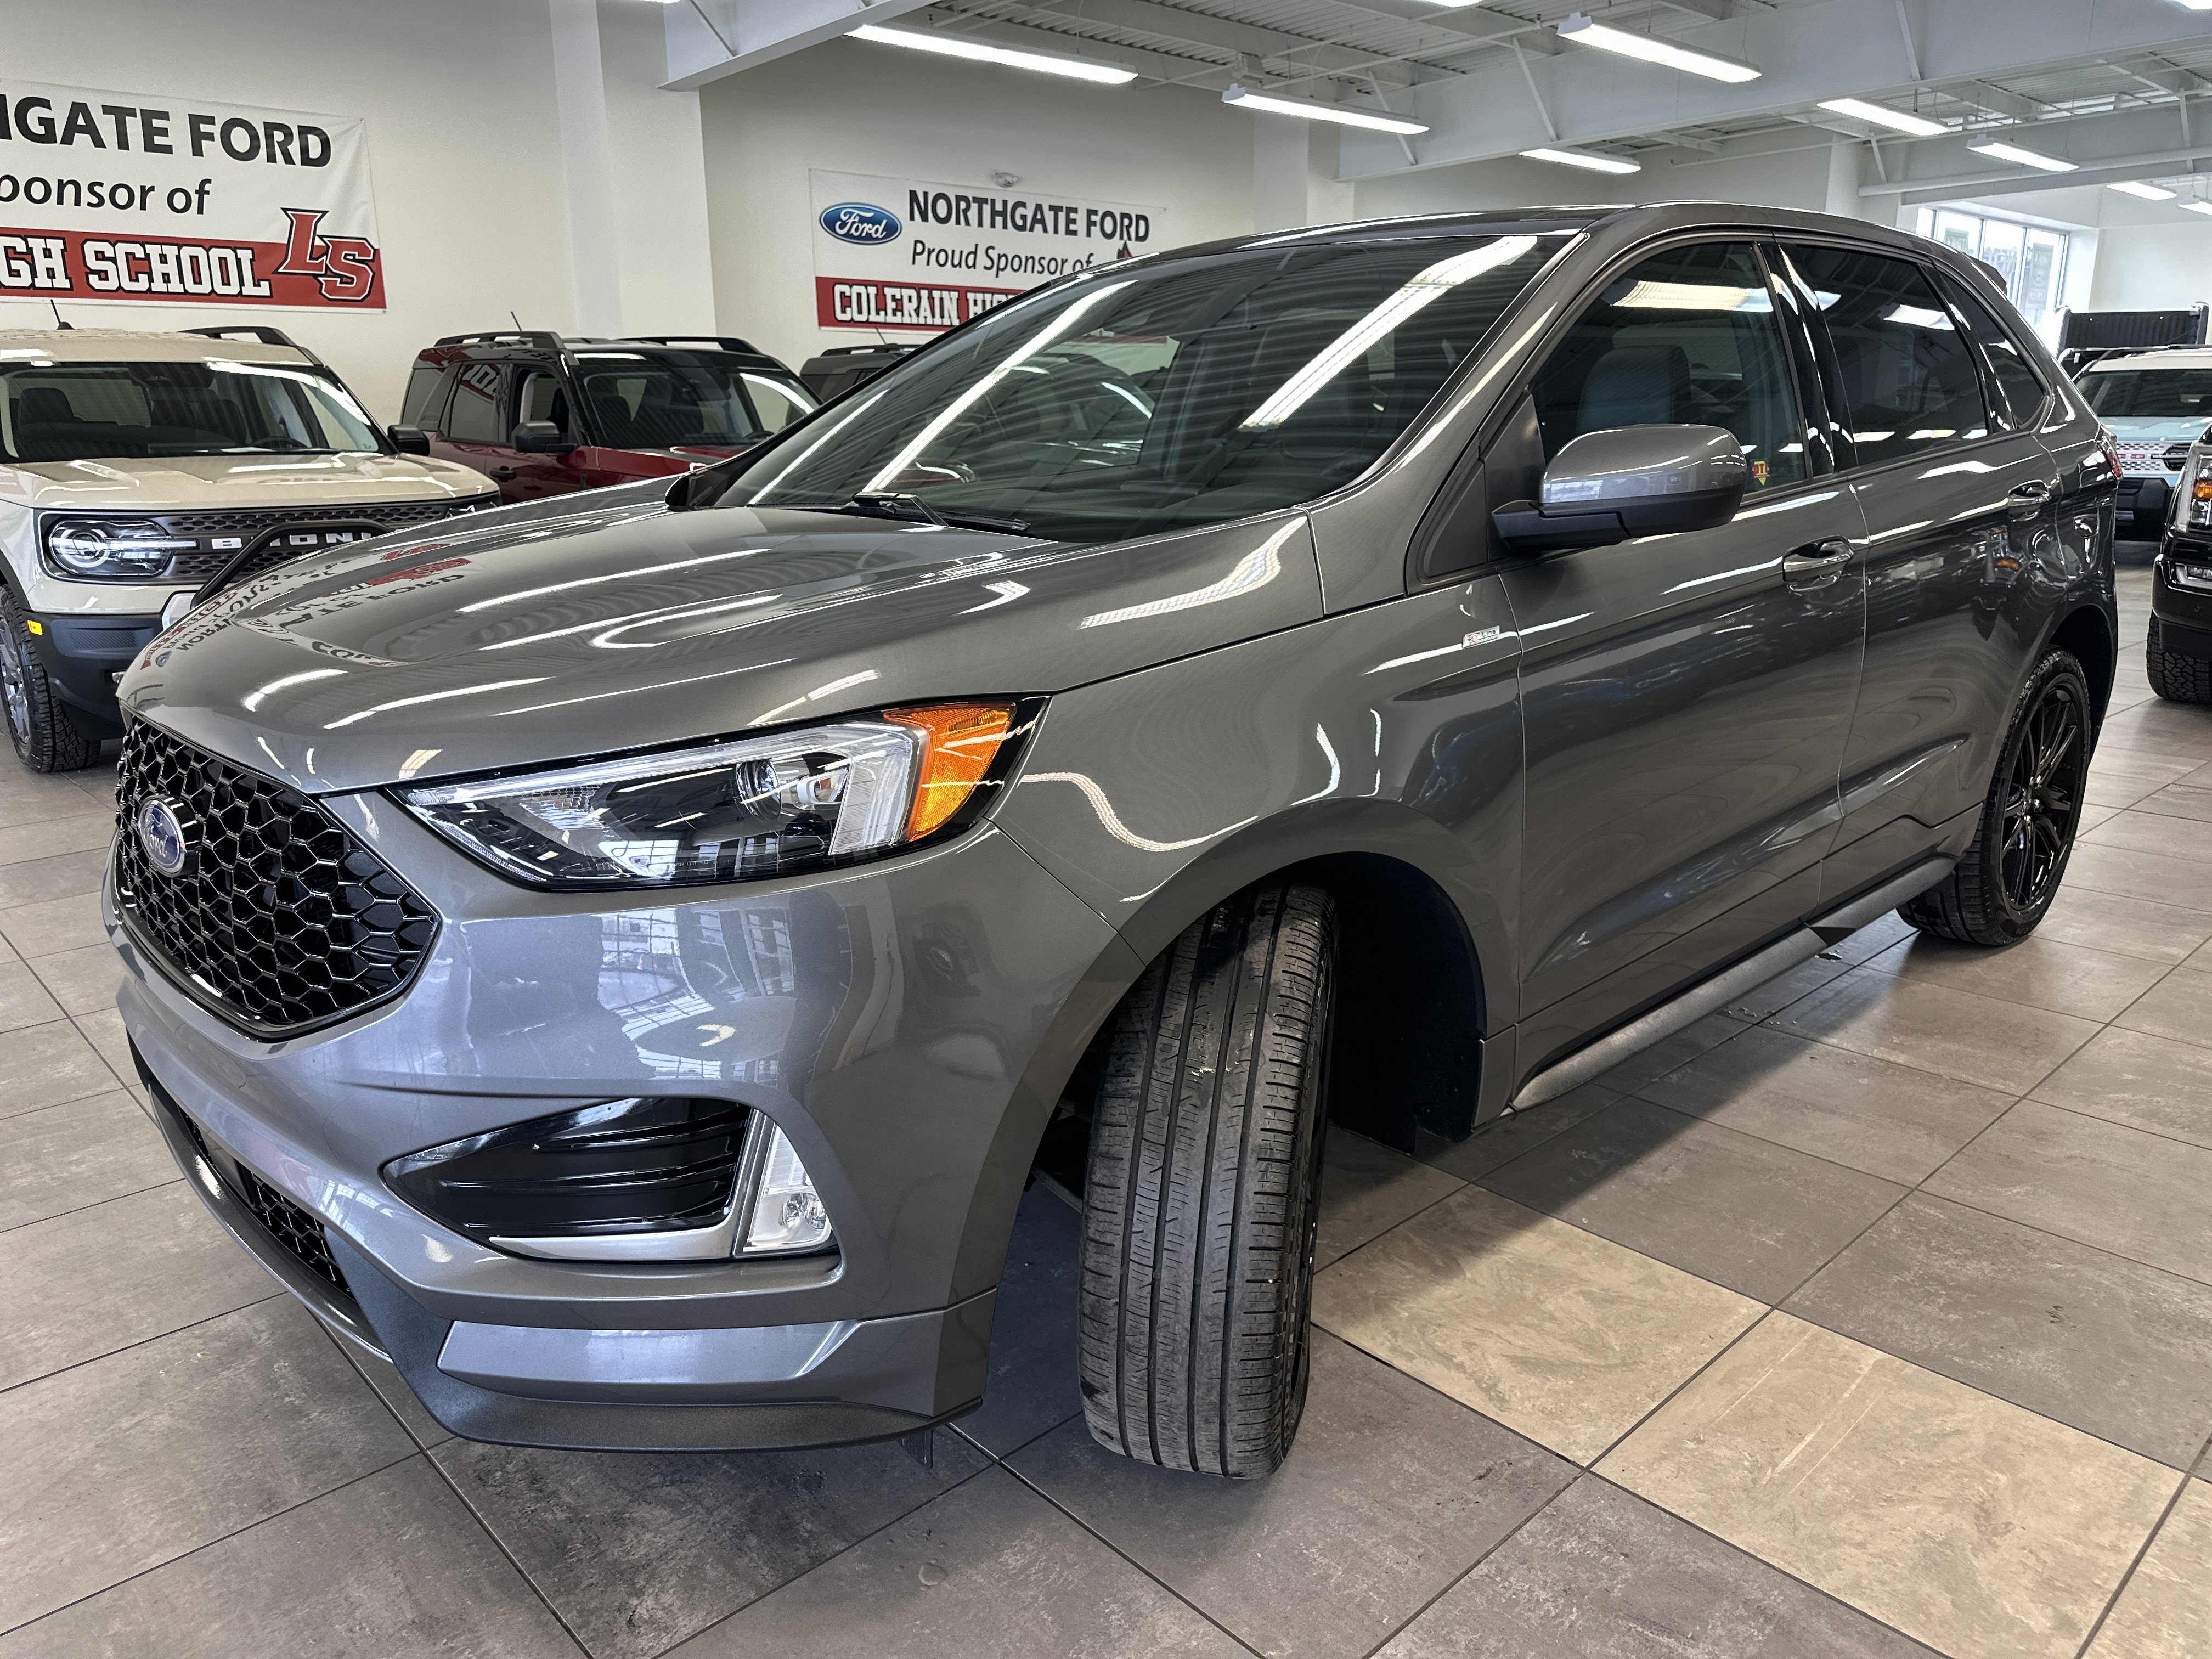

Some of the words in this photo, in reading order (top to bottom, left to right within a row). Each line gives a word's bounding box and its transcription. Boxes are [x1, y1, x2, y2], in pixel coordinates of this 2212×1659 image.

[0, 93, 173, 155] GATE
[188, 114, 332, 167] FORD
[166, 178, 212, 215] of
[909, 189, 1078, 237] NORTHGATE
[1086, 209, 1150, 242] FORD
[834, 208, 887, 239] Ford
[81, 239, 273, 299] SCHOOL
[272, 208, 380, 302] LS
[911, 240, 978, 270] Proud
[983, 245, 1068, 278] Sponsor
[833, 283, 960, 327] COLERAIN
[143, 812, 168, 858] Ford
